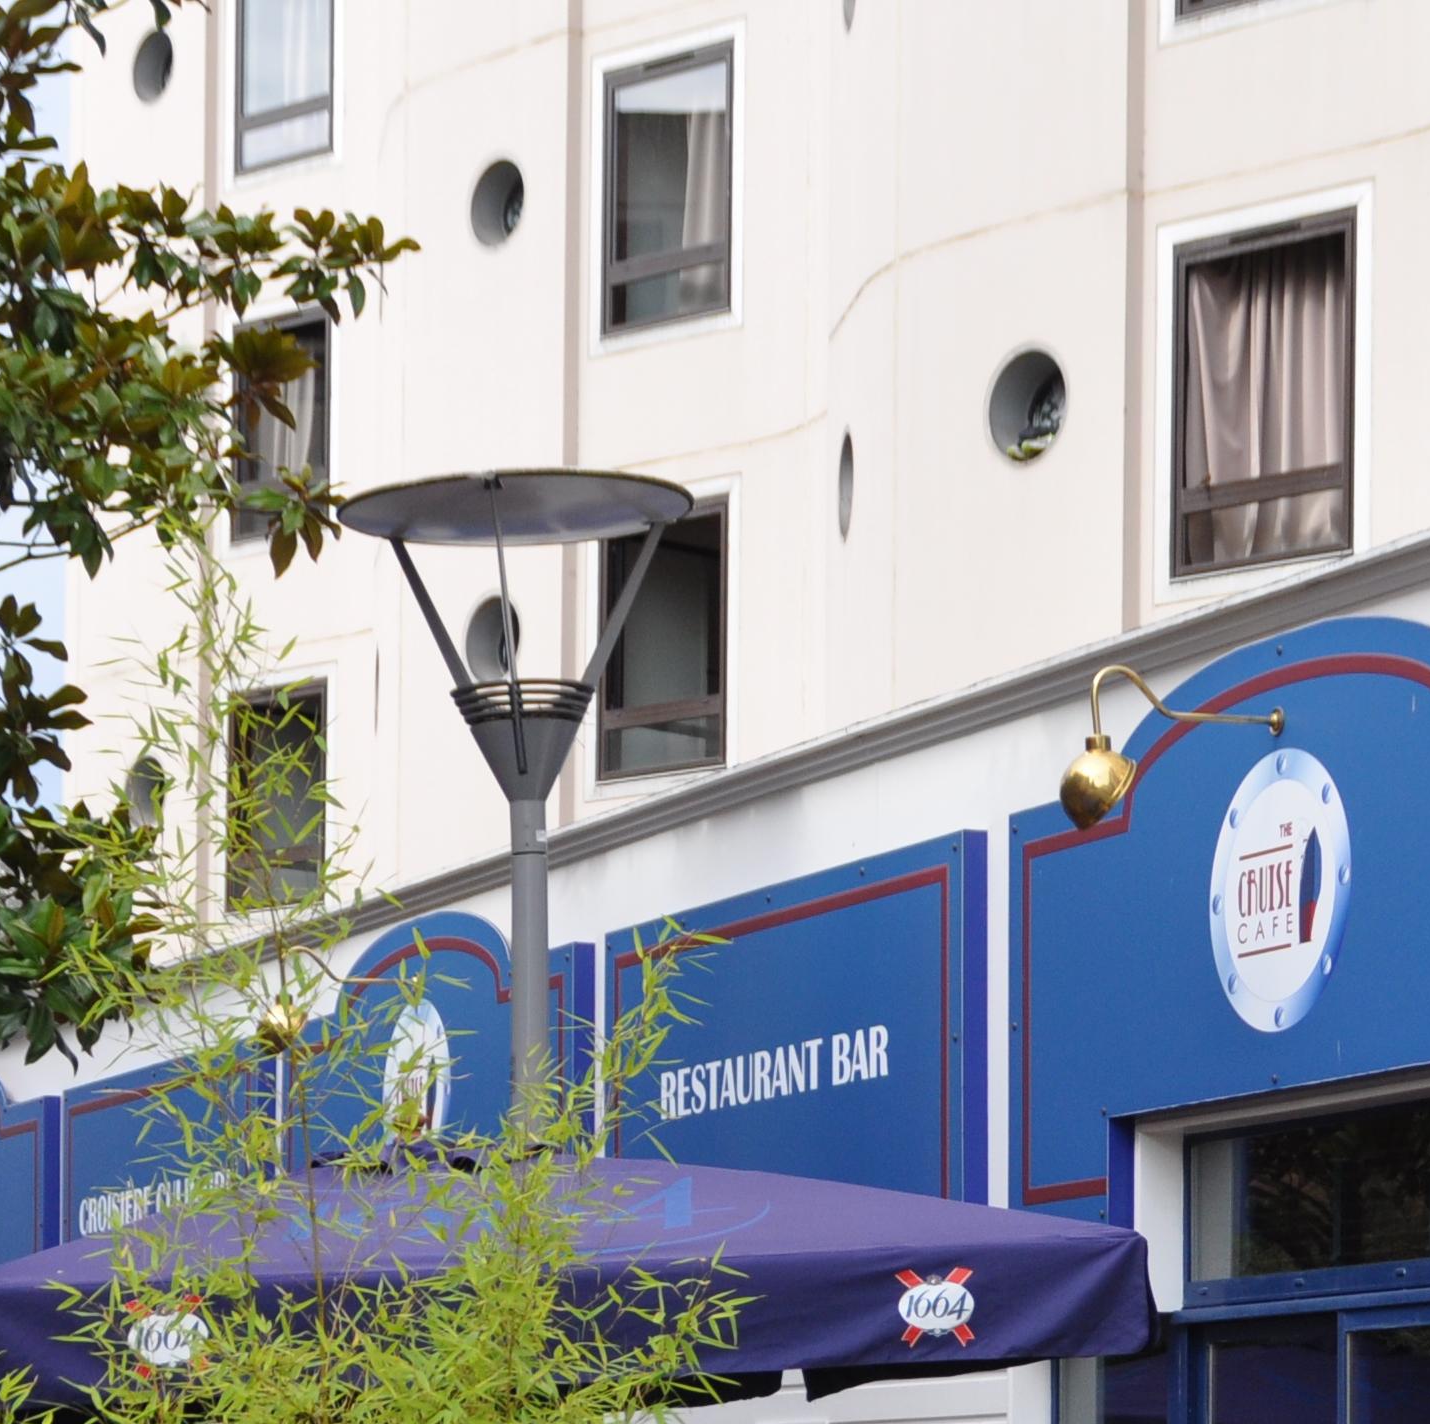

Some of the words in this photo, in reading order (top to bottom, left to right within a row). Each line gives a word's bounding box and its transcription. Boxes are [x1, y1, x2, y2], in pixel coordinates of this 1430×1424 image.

[1279, 821, 1294, 838] THE
[1238, 860, 1293, 918] CRUISE
[1237, 912, 1294, 944] CAFE
[660, 1038, 823, 1121] RESTAURANT
[831, 1024, 889, 1087] BAR
[905, 1287, 971, 1321] 1664
